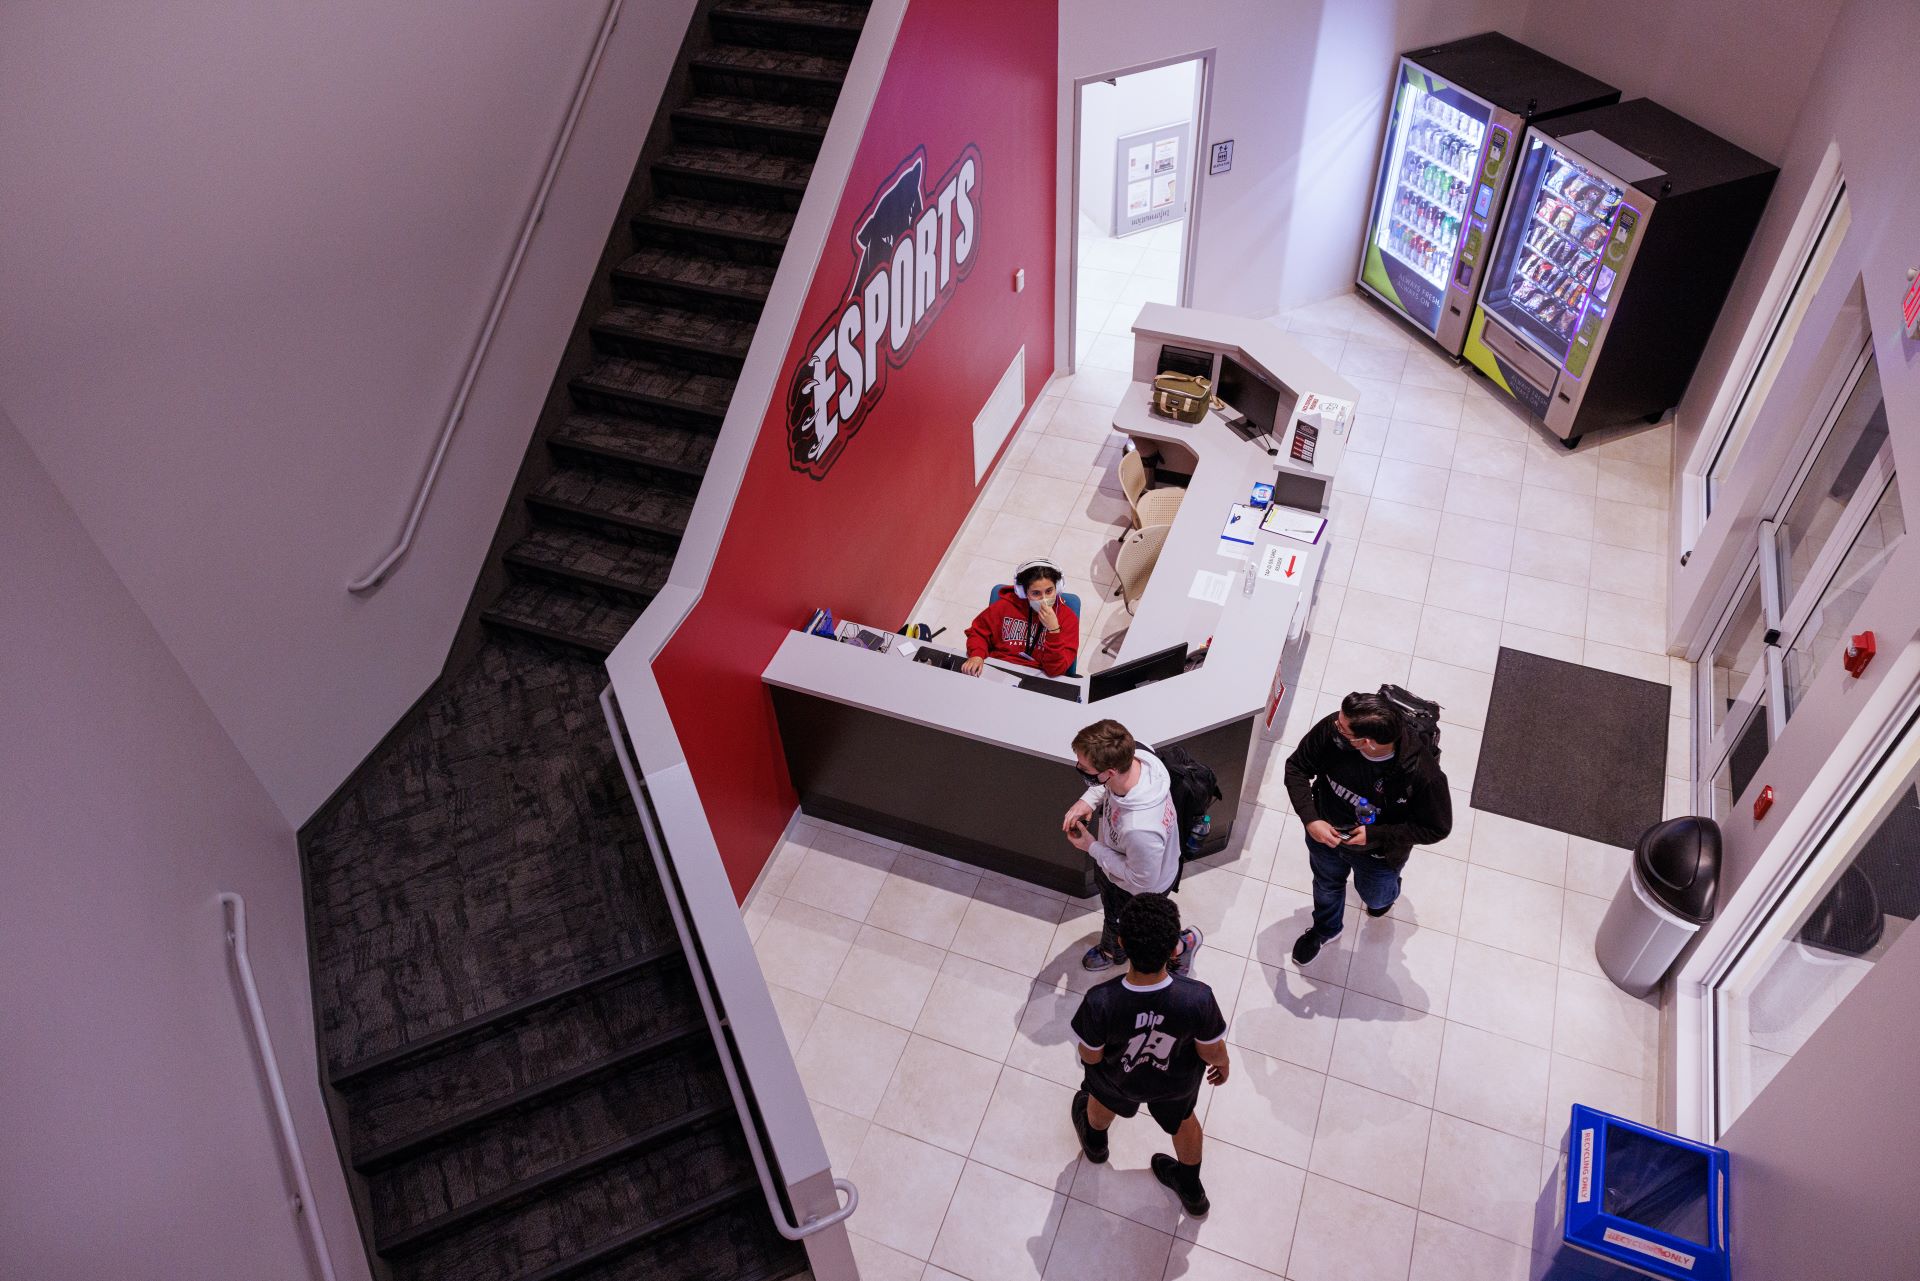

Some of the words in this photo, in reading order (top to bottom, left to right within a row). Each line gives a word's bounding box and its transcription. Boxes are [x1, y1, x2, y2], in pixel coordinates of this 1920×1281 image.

[812, 158, 976, 462] ESPORTS
[1420, 296, 1430, 308] ON
[1134, 1010, 1165, 1031] Dip
[1123, 1029, 1177, 1061] 19
[1582, 1132, 1591, 1176] RECYCLING
[1581, 1176, 1589, 1198] ONLY
[1663, 1250, 1690, 1265] ONLY
